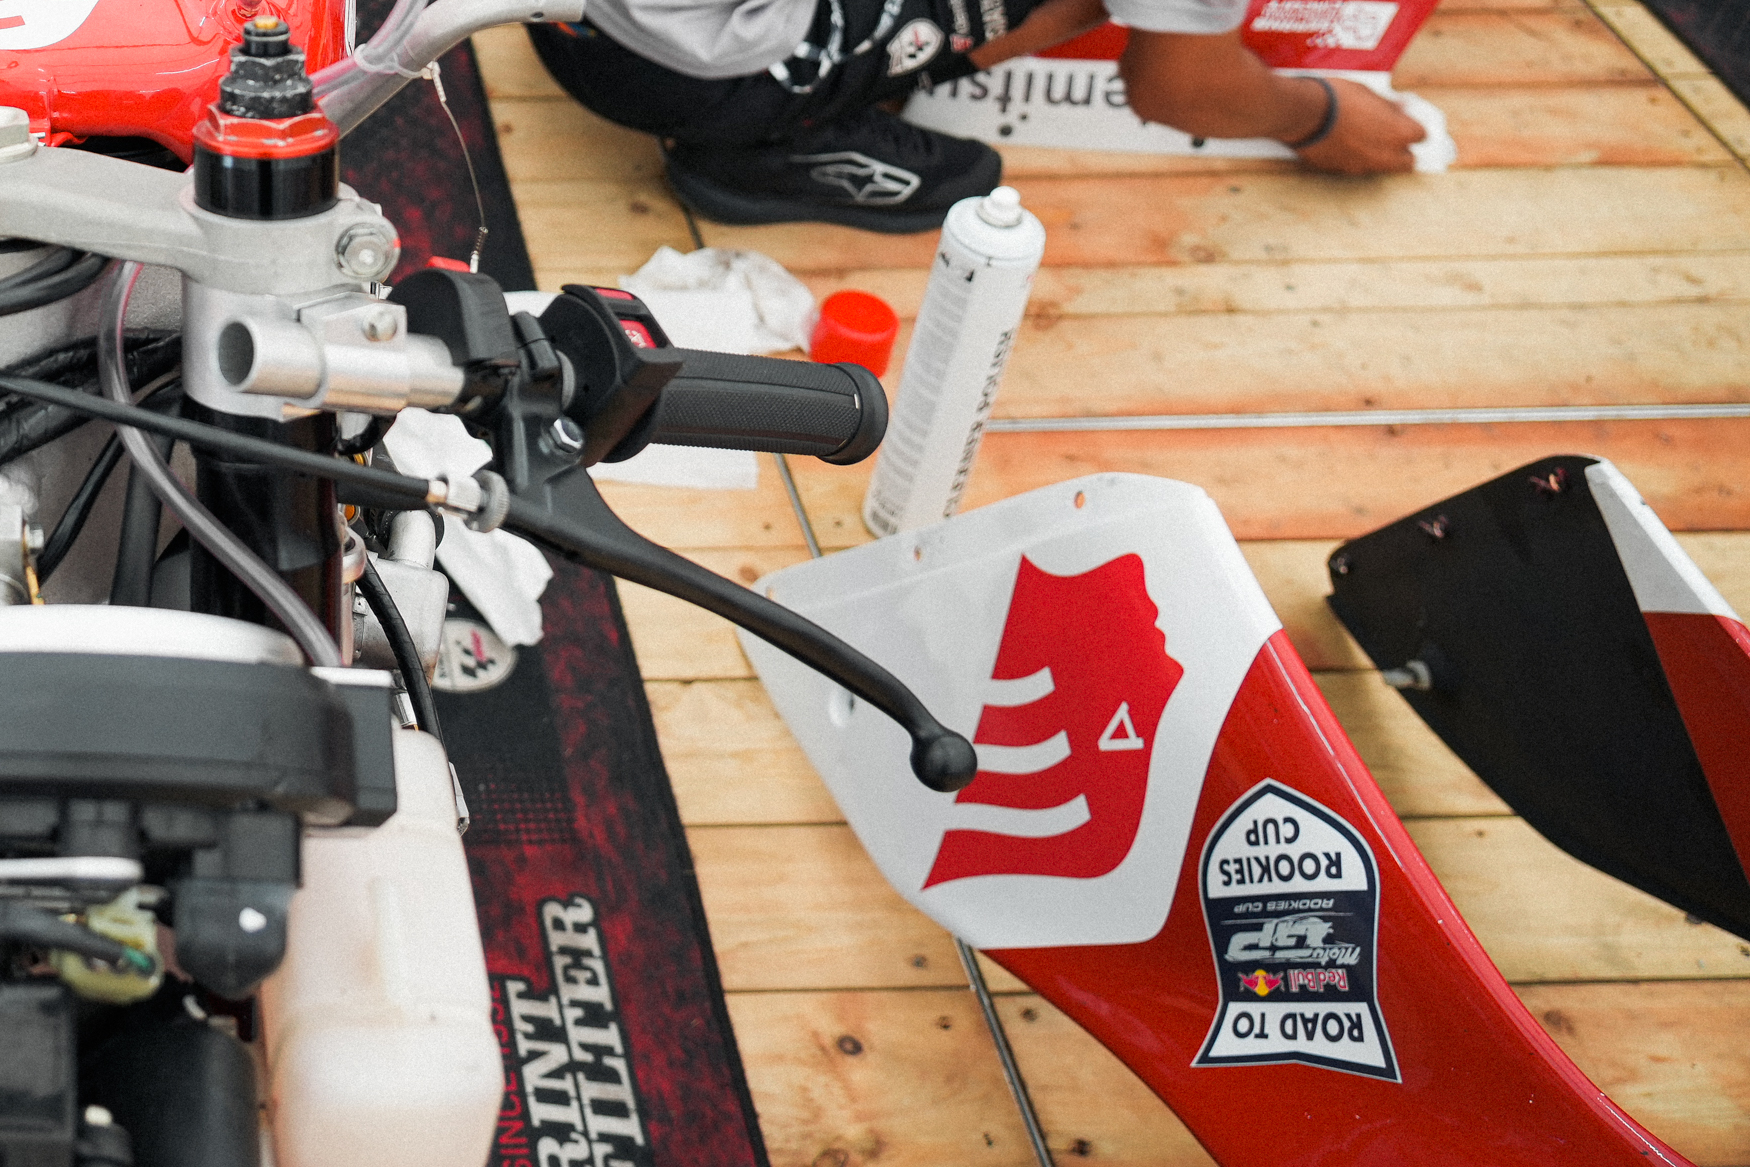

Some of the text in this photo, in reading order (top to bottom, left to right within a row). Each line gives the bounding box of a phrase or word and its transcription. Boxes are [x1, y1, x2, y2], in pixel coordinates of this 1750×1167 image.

[1245, 816, 1300, 847] CUP
[1219, 851, 1343, 887] ROOKIES
[1233, 897, 1335, 914] ROOKIES CUP
[1232, 1011, 1365, 1043] ROAD TO
